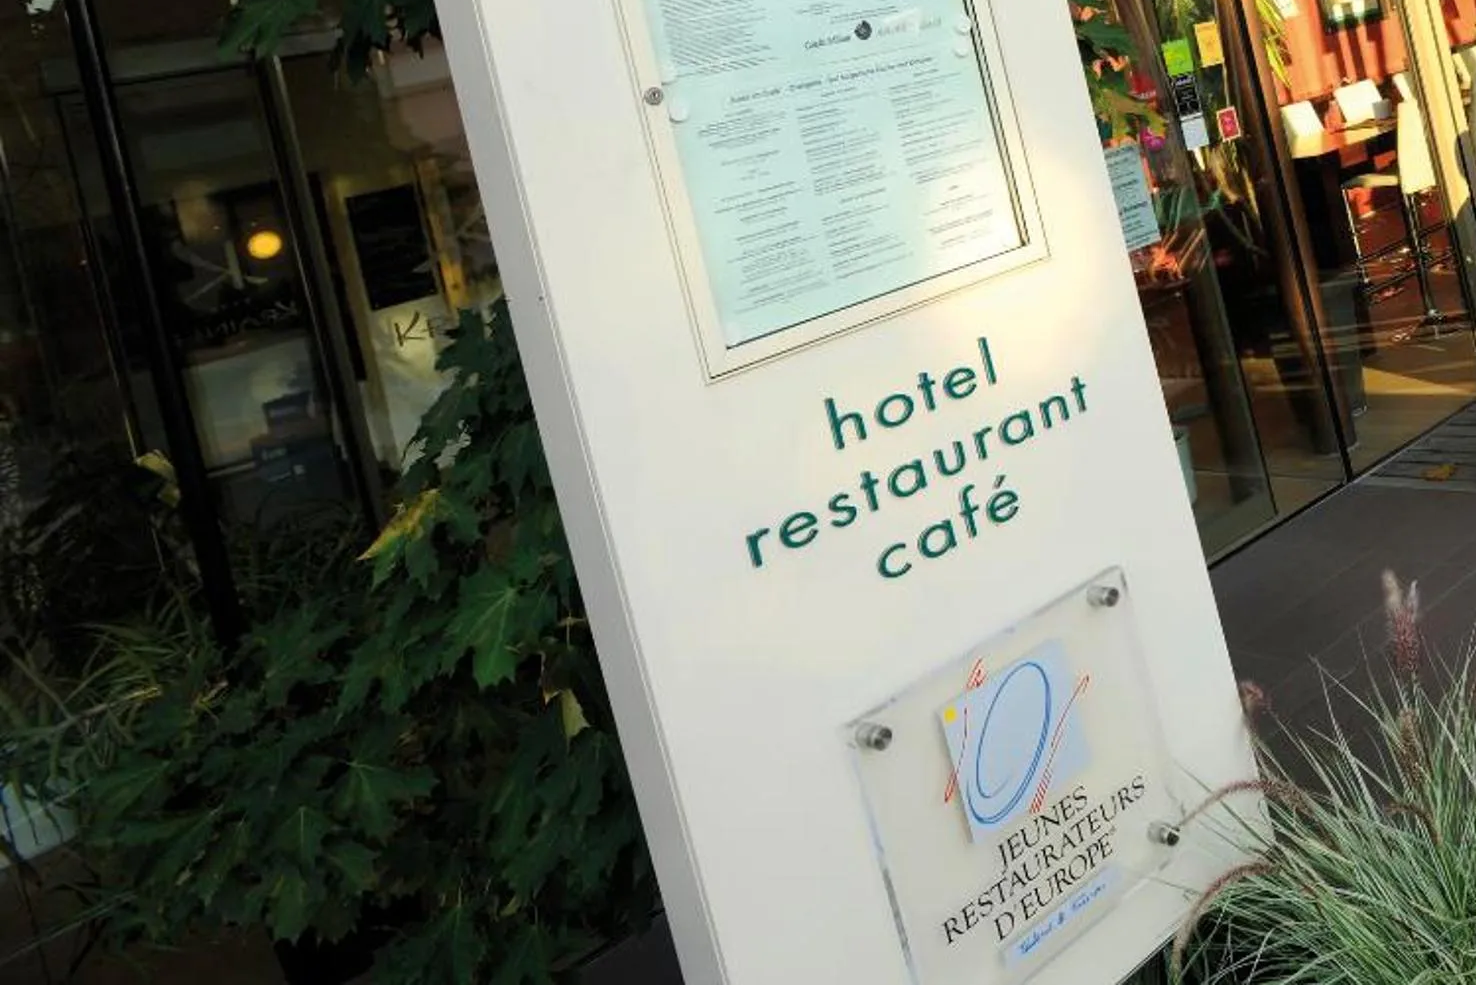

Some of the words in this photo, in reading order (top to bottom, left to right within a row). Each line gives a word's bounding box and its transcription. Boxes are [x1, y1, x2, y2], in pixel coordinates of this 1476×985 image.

[824, 336, 997, 450] hotel
[745, 377, 1087, 568] restaurant
[876, 475, 1020, 579] café
[943, 775, 1146, 944] RESTAURATEURS
[997, 786, 1089, 874] JEUNES
[994, 833, 1114, 941] D'EUROPE
